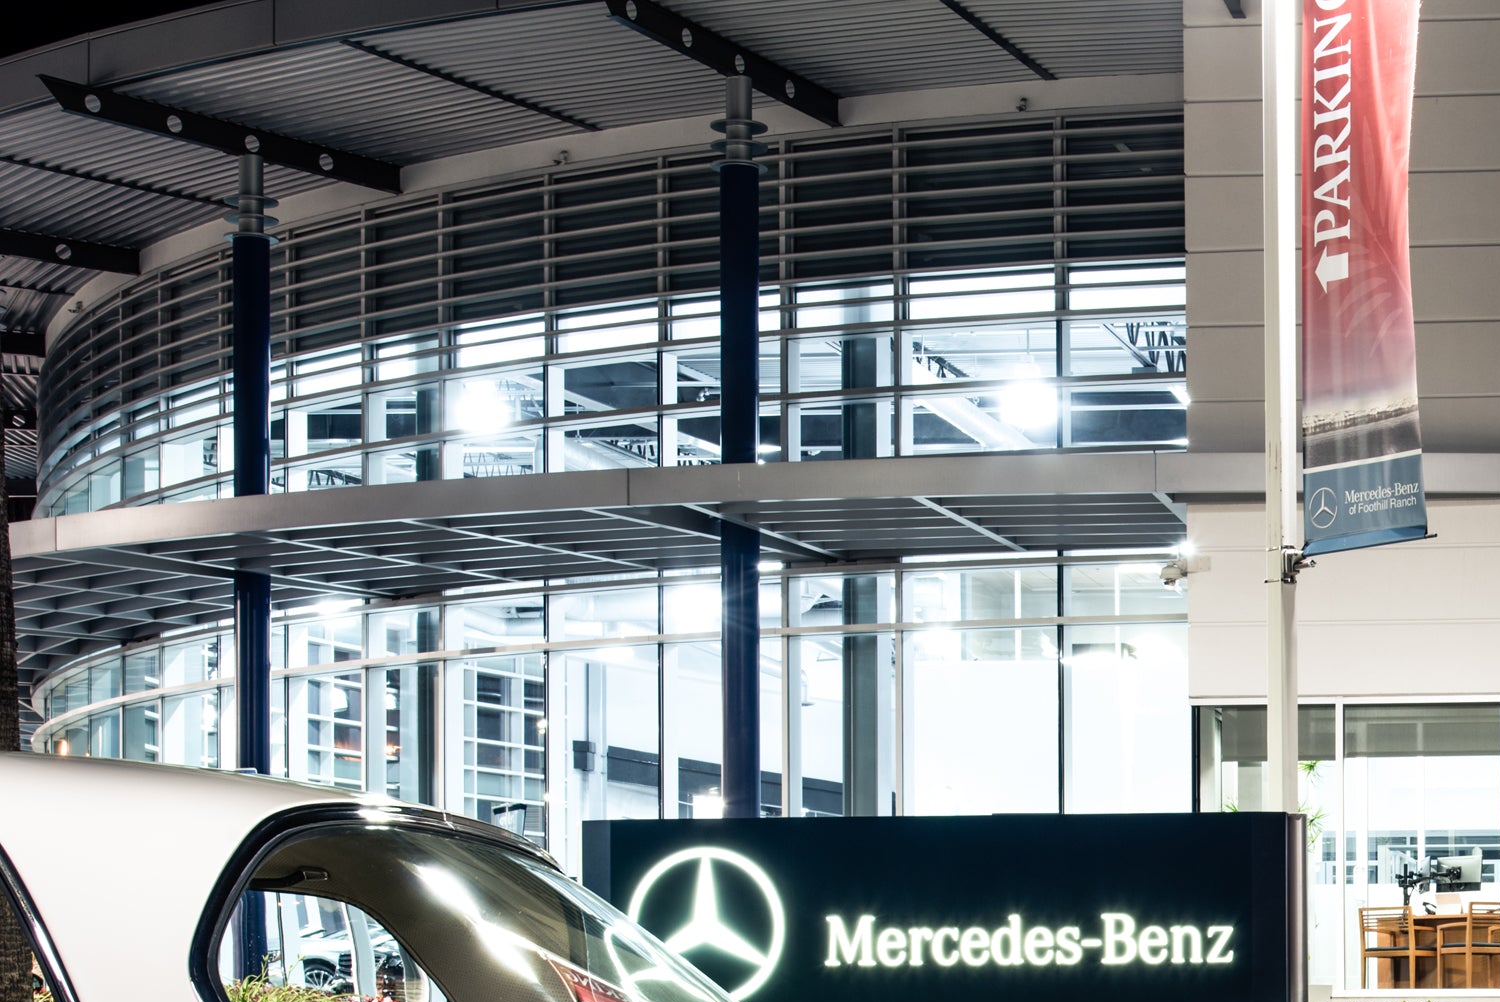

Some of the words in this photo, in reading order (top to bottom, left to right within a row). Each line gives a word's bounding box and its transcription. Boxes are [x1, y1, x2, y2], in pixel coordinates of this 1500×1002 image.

[1314, 0, 1352, 247] PARKIN
[1344, 482, 1420, 505] Mercedes-Benz
[1348, 503, 1357, 516] of
[1358, 499, 1389, 514] Foothill
[1390, 495, 1417, 509] Ranch
[824, 913, 1235, 967] Mercedes-Benz
